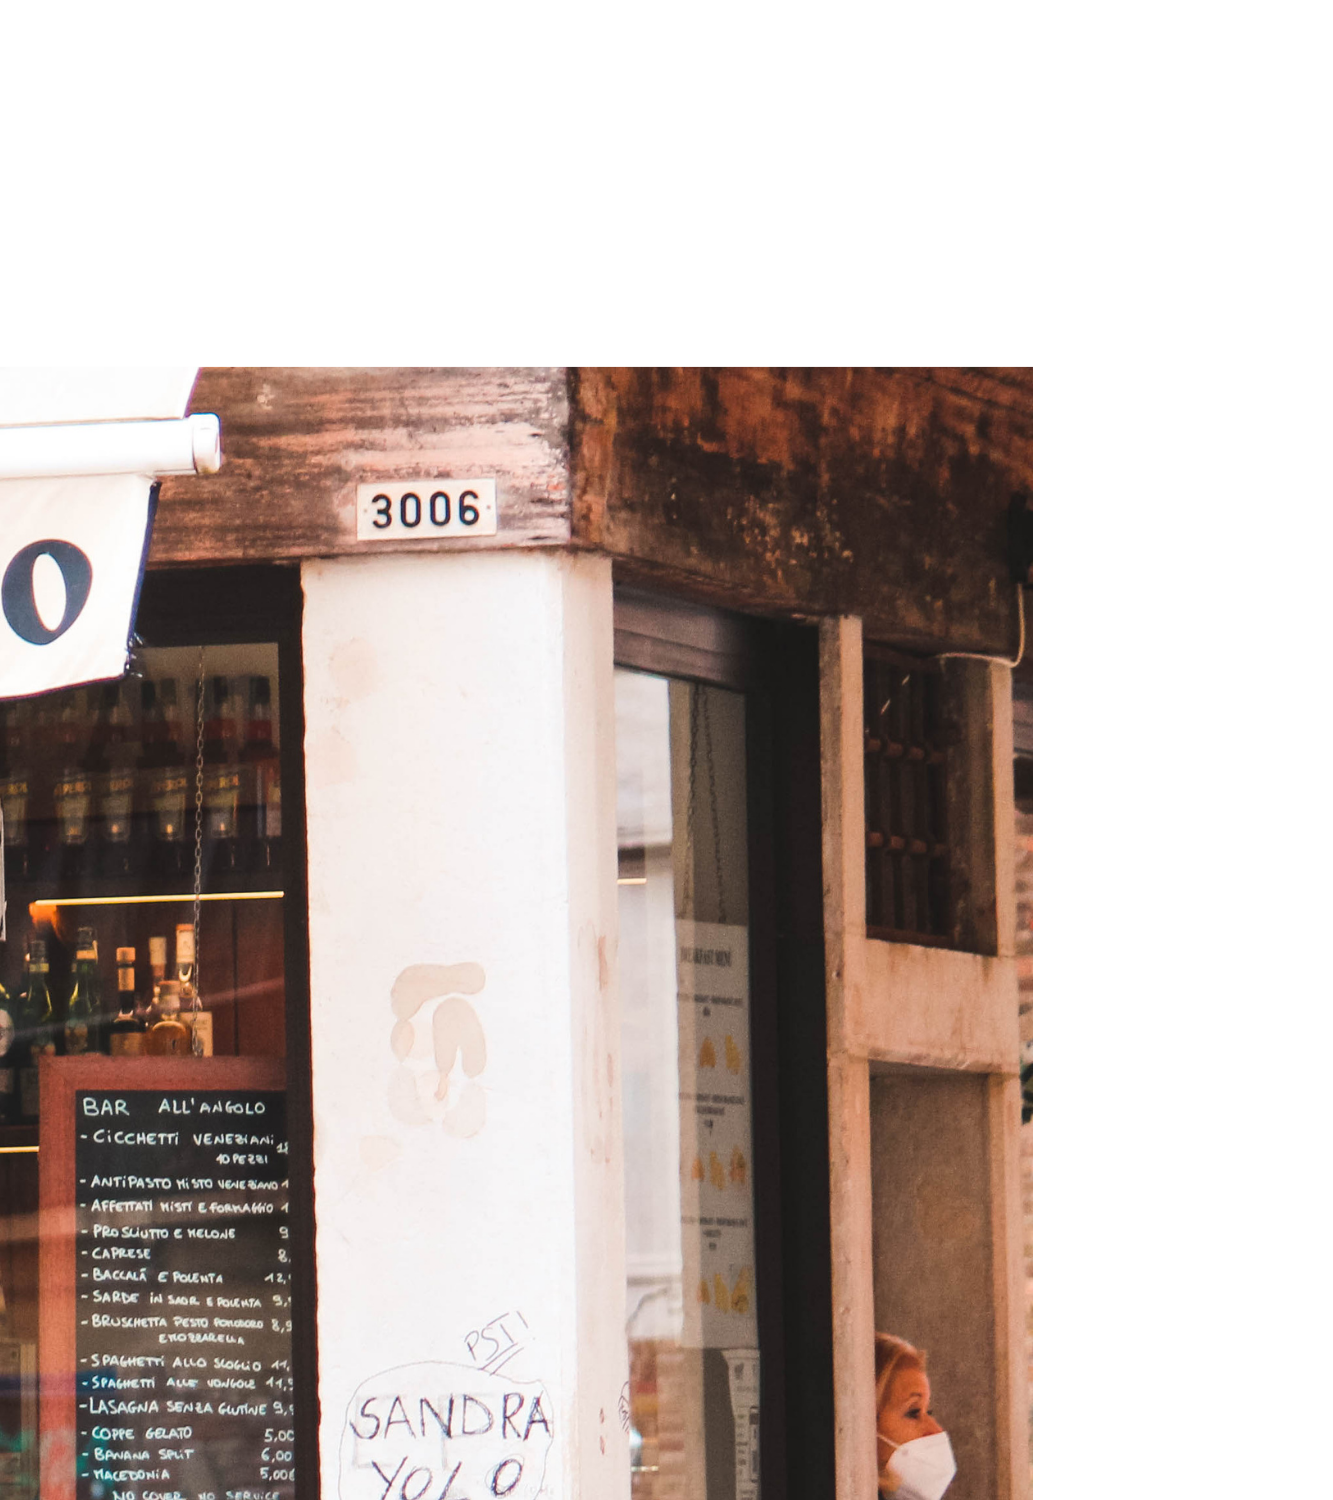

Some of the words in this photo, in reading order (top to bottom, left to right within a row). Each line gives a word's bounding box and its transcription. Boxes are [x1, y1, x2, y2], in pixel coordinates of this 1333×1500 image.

[371, 490, 480, 528] 3006
[83, 1097, 130, 1116] BAR
[187, 1228, 235, 1240] MELONE
[91, 1247, 152, 1260] CAPRESE
[158, 1271, 168, 1282] E
[173, 1271, 223, 1284] POLENTA
[92, 1290, 140, 1304] SARDE
[91, 1313, 168, 1328] BRUSCHETTA
[173, 1316, 208, 1328] PESTO
[172, 1357, 208, 1368] ALLO
[166, 1378, 198, 1389] ALLE
[89, 1397, 159, 1414] LASAGNA
[167, 1400, 213, 1414] SENZA
[350, 1390, 552, 1441] SANDRA
[91, 1426, 135, 1440] COPPE
[145, 1426, 193, 1439] GELATO
[94, 1448, 150, 1460] BANANA
